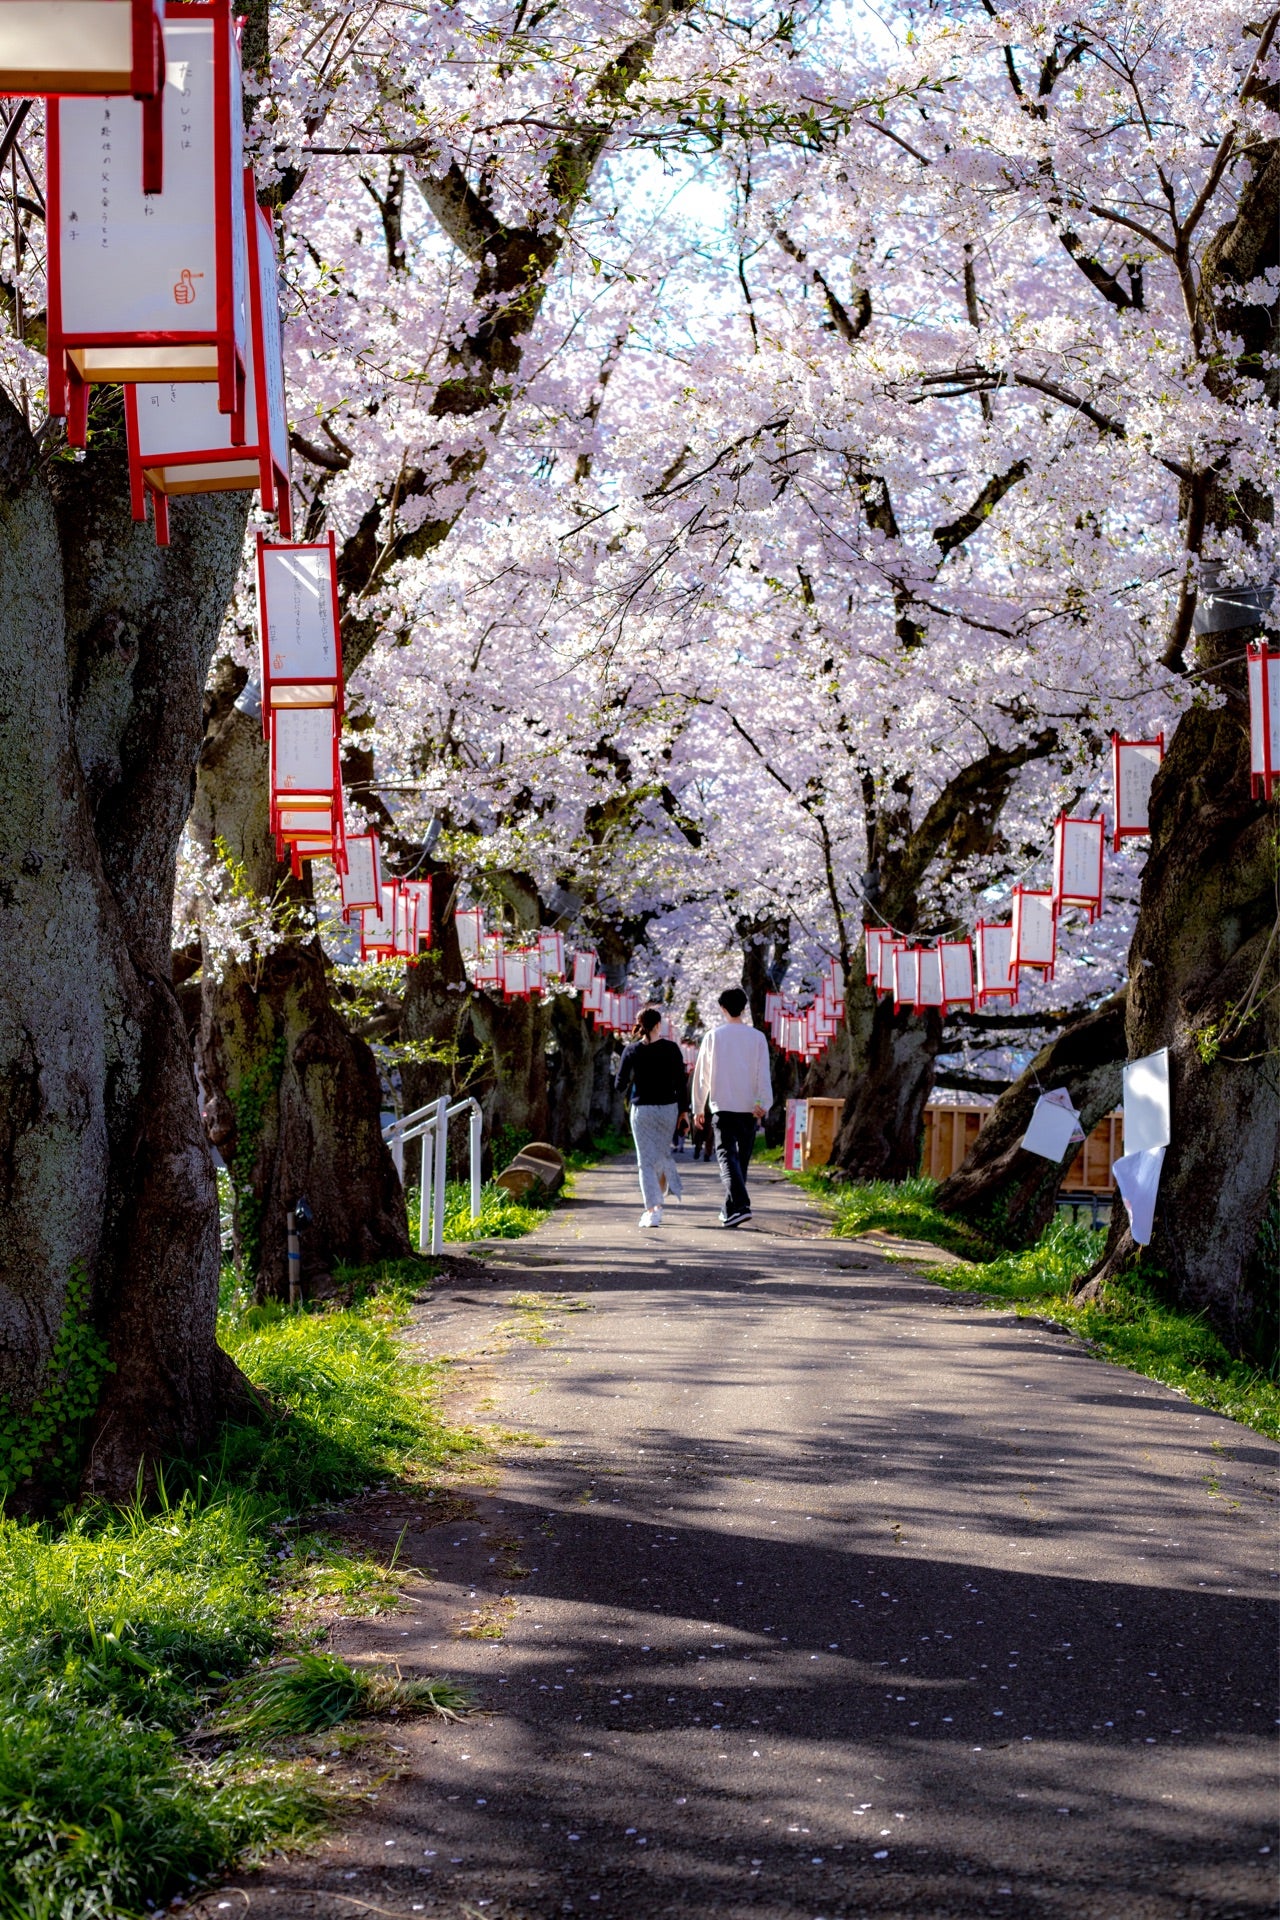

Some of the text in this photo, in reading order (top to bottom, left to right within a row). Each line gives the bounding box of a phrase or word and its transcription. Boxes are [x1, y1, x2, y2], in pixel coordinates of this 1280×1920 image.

[100, 96, 112, 248] 身赴任の父と会うとき
